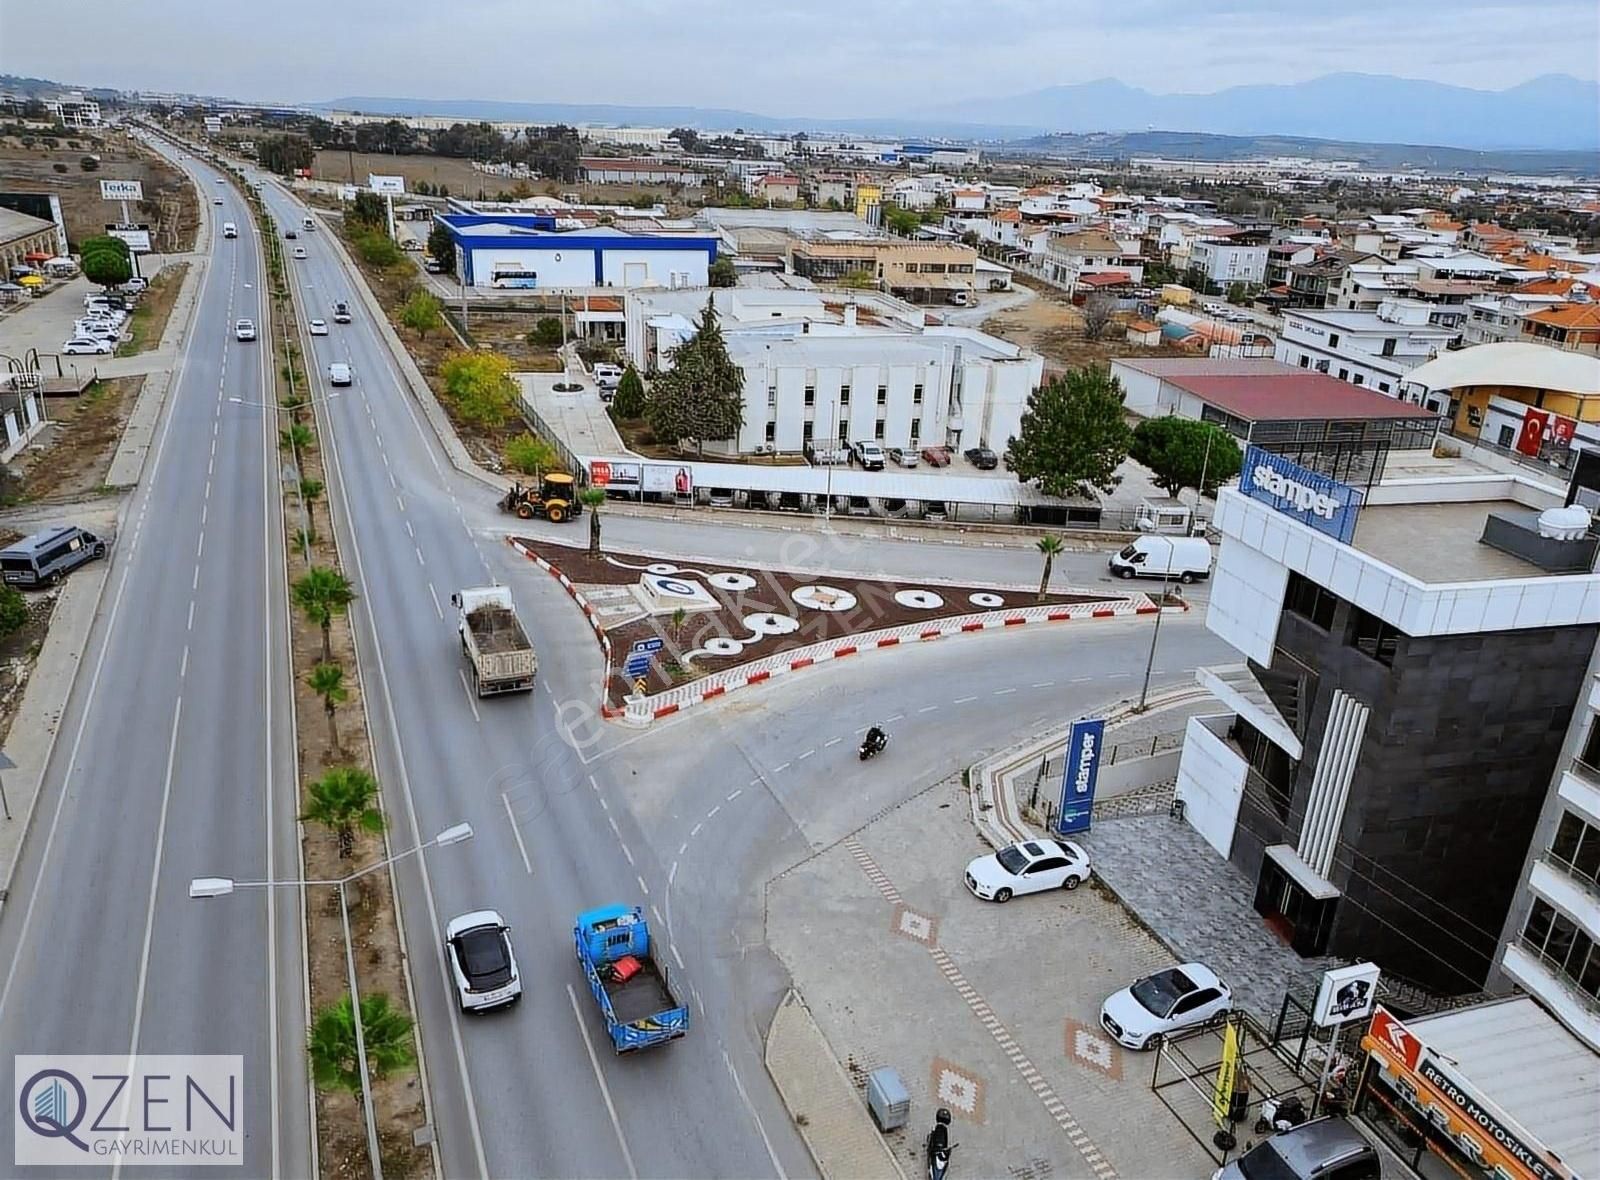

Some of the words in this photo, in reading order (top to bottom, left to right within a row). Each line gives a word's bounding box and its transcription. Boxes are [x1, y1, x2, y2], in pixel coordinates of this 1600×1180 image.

[1252, 465, 1340, 519] stamper
[1075, 732, 1095, 793] stamper
[1426, 1067, 1466, 1106] RETRO
